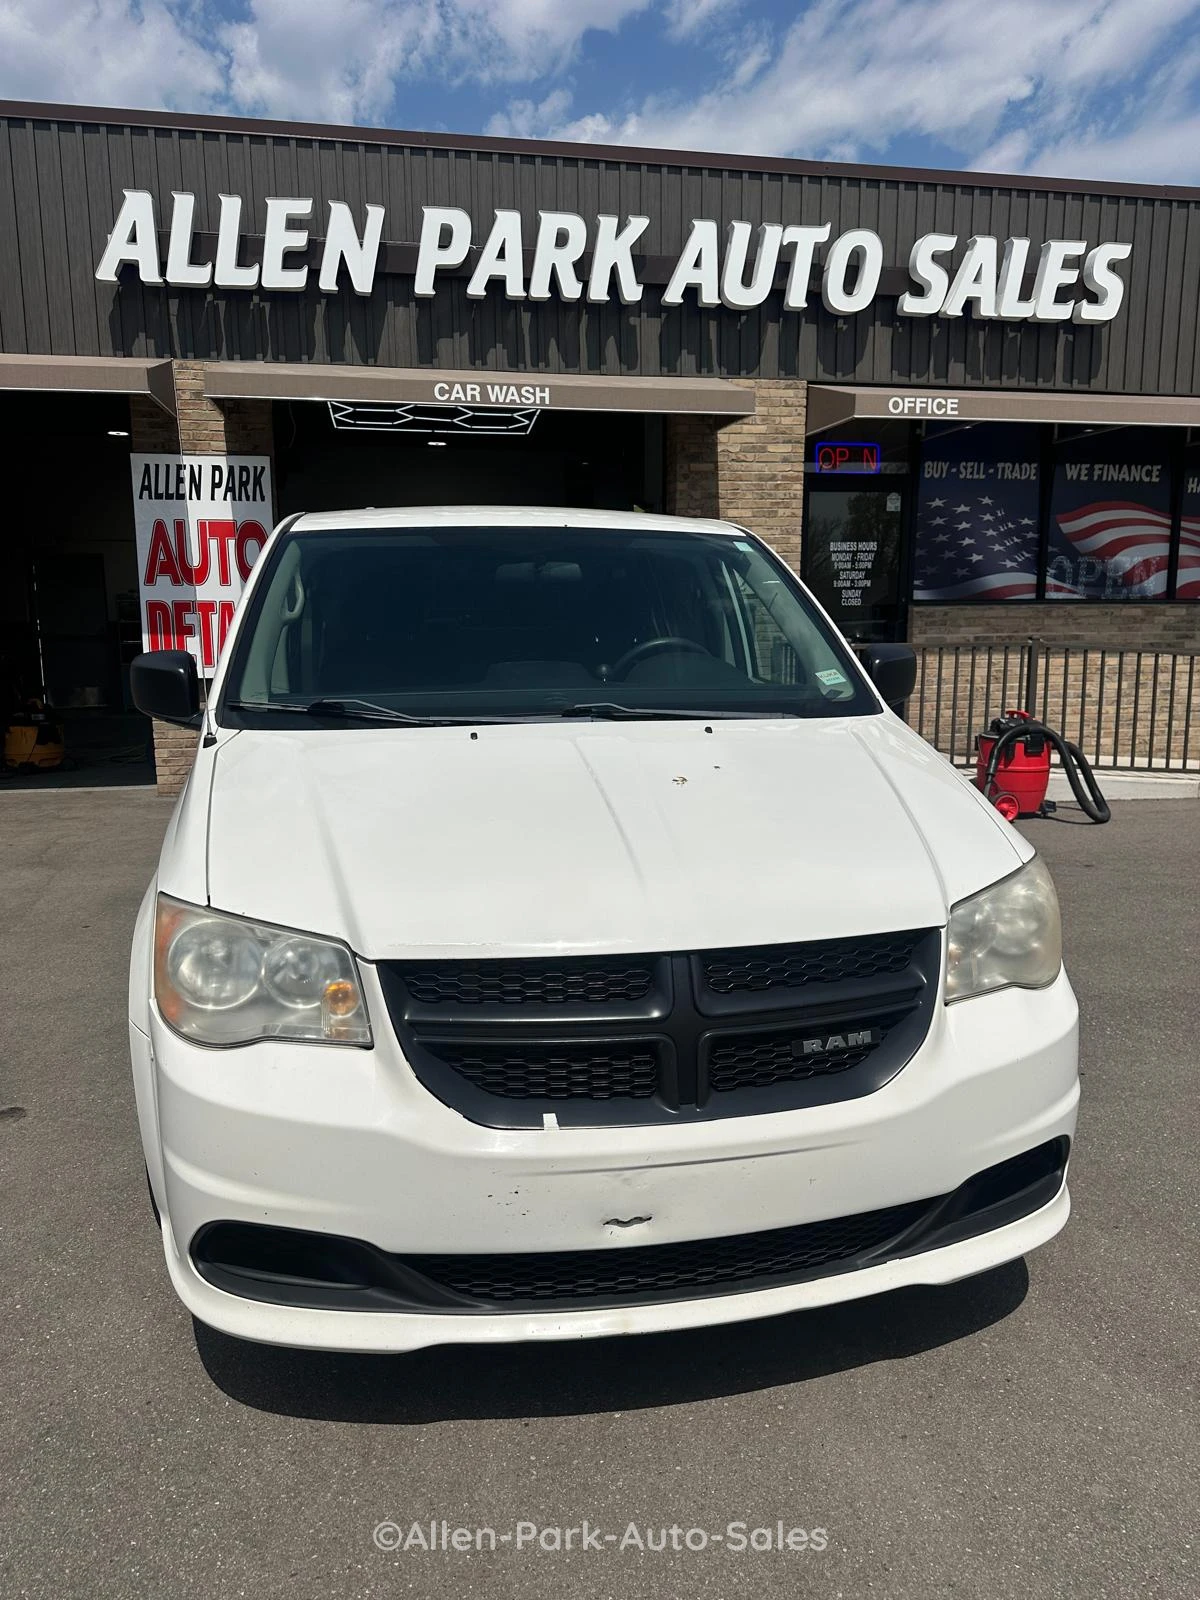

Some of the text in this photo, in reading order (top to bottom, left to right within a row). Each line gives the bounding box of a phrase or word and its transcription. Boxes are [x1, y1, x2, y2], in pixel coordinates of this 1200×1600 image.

[95, 188, 1132, 325] ALLEN PARK AUTO SALES
[433, 382, 550, 405] CAR WASH
[888, 396, 959, 415] OFFICE
[819, 447, 877, 471] OPN
[924, 461, 949, 479] BUY
[959, 461, 985, 480] SELL
[997, 462, 1038, 481] TRADE
[1065, 463, 1162, 483] WE FINANCE
[138, 463, 266, 502] ALLEN PARK
[144, 518, 270, 587] AUTO
[830, 541, 878, 551] BUSINESS HOURS
[831, 552, 853, 562] MONDAY
[857, 552, 875, 561] FRIDAY
[839, 571, 866, 580] SATURDAY
[841, 589, 862, 598] SUNDAY
[841, 598, 862, 606] CLOSED
[803, 1030, 872, 1054] RAM
